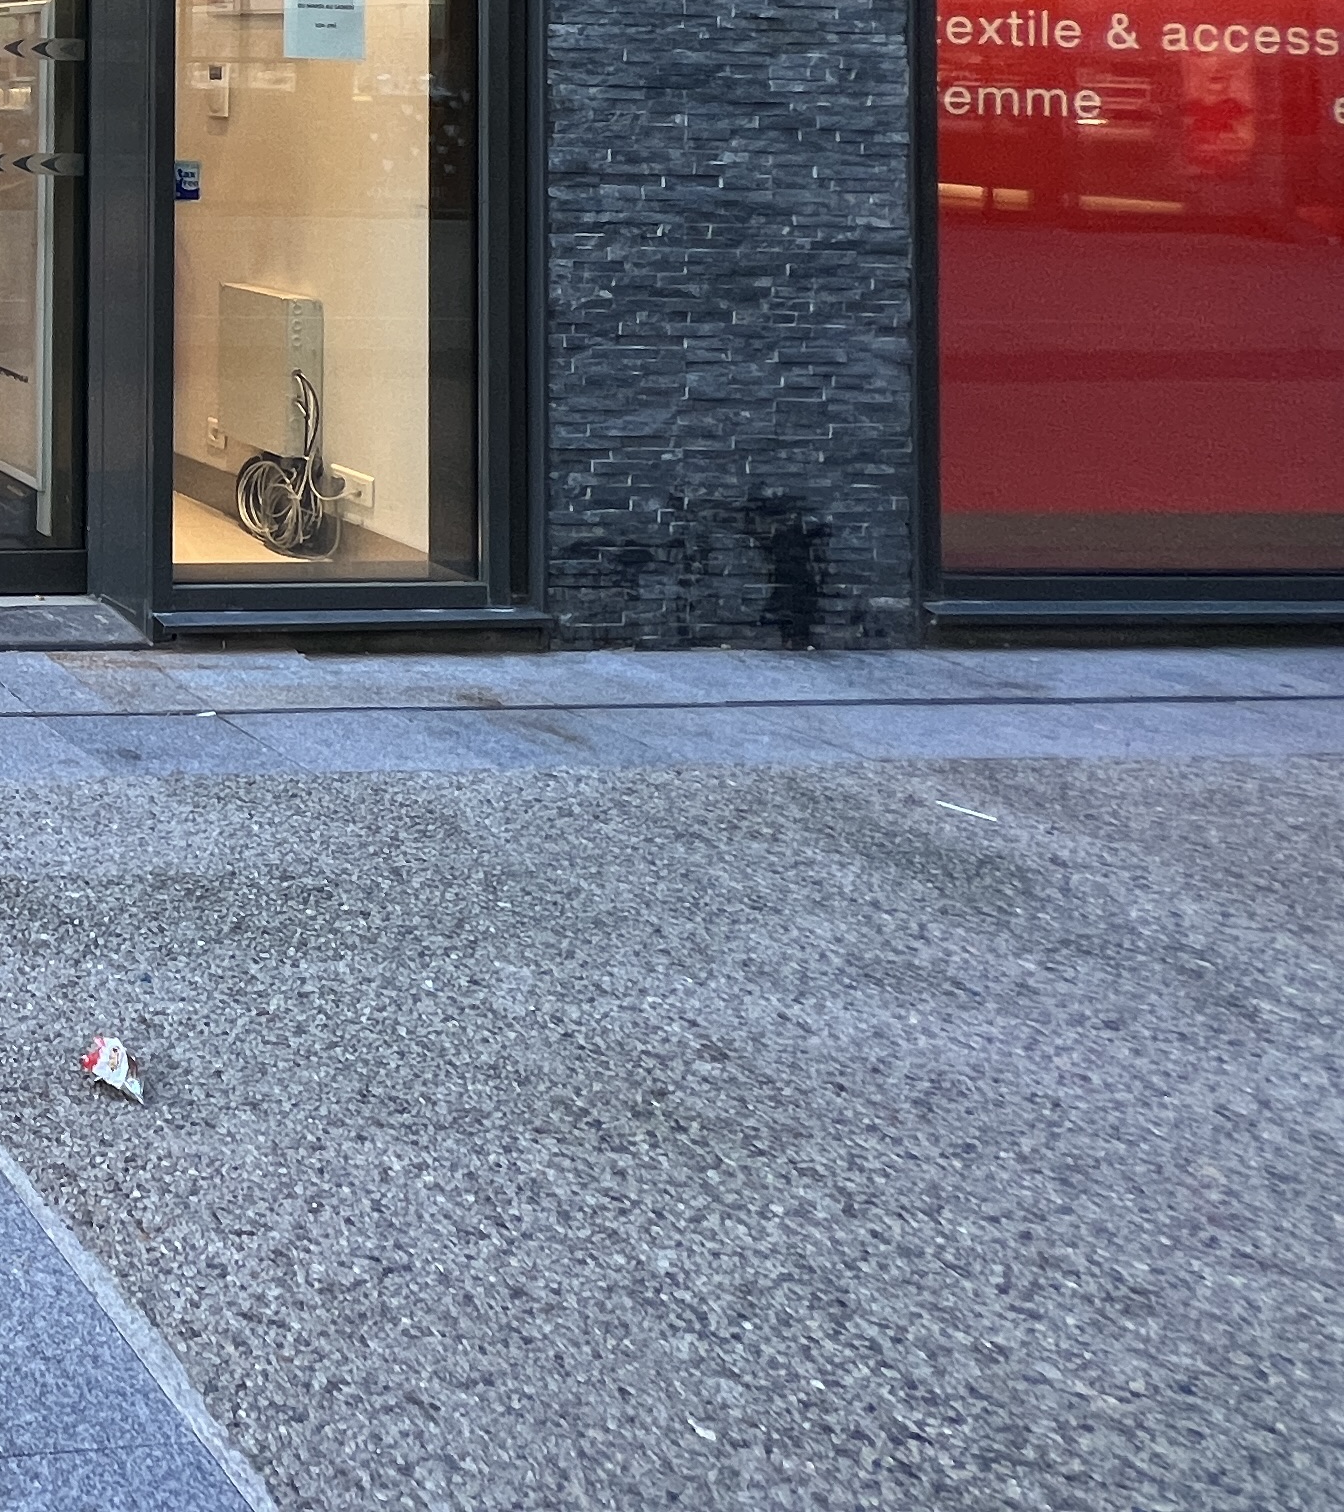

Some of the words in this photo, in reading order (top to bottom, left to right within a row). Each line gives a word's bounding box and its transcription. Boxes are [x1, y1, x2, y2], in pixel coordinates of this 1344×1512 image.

[936, 9, 1082, 49] extile
[1106, 12, 1140, 50] &
[1161, 21, 1340, 57] access
[938, 86, 1102, 118] emme
